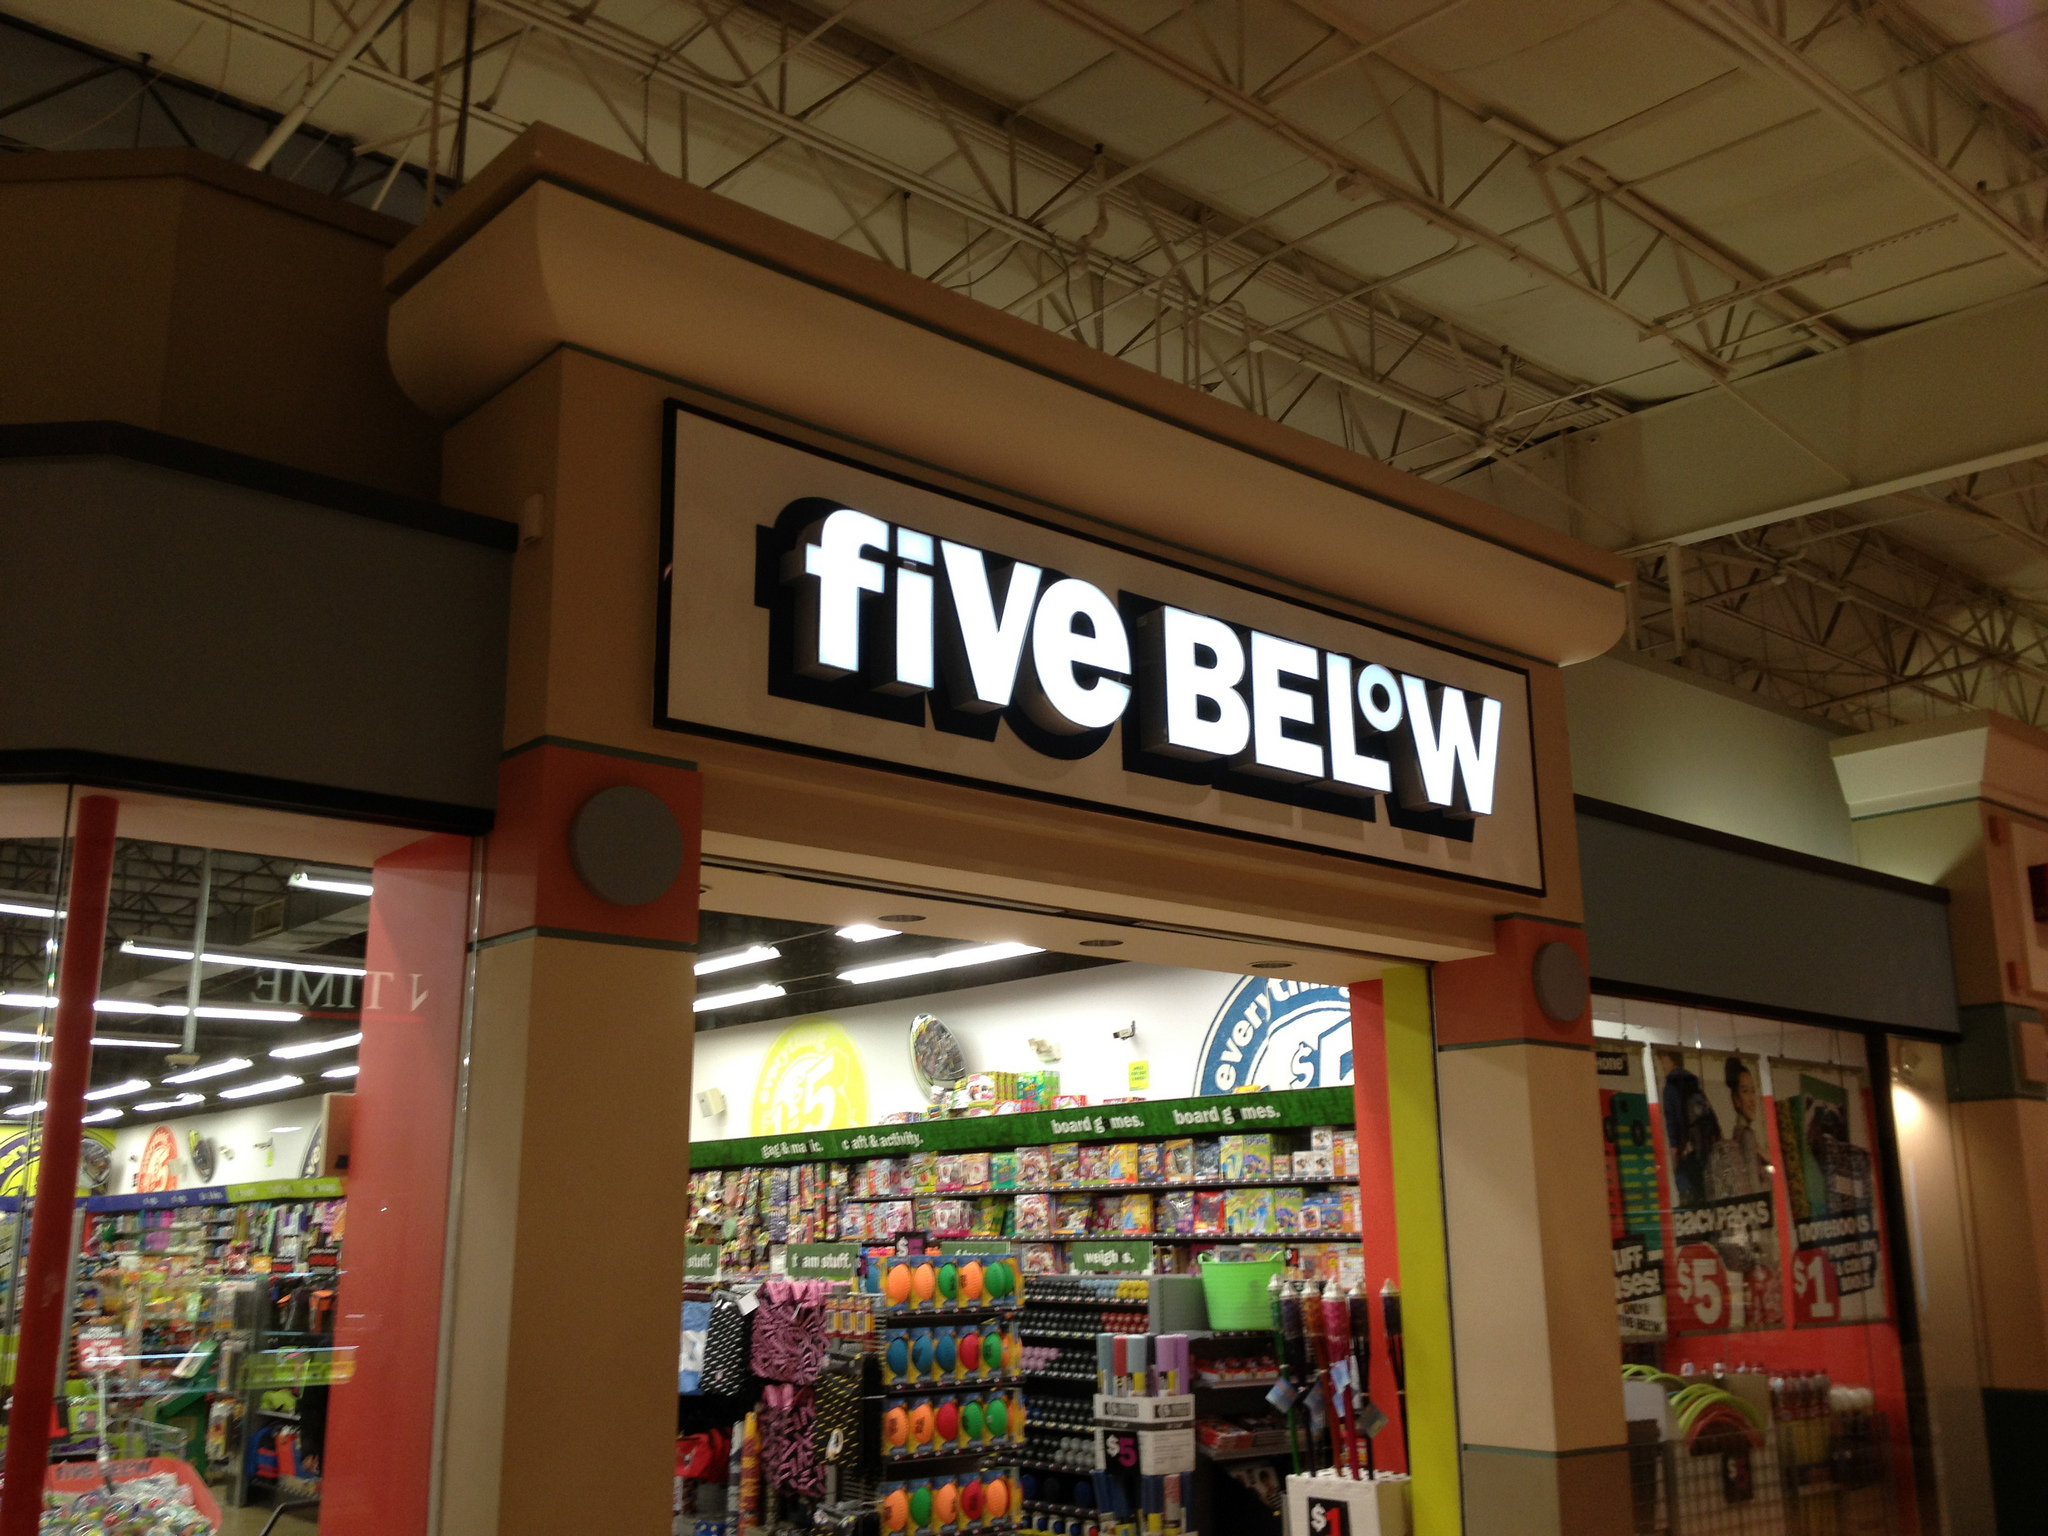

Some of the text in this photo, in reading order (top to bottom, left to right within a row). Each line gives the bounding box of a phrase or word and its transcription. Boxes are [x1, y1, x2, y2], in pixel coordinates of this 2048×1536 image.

[805, 509, 1133, 730] five
[1051, 1116, 1093, 1135] board
[1173, 1105, 1220, 1126] board
[841, 1134, 870, 1151] caft
[791, 1252, 821, 1269] tam
[1083, 1248, 1136, 1267] weighs.
[1677, 1257, 1722, 1325] $5
[1793, 1255, 1835, 1317] $1
[1105, 1433, 1138, 1468] $5
[1310, 1502, 1342, 1536] $1
